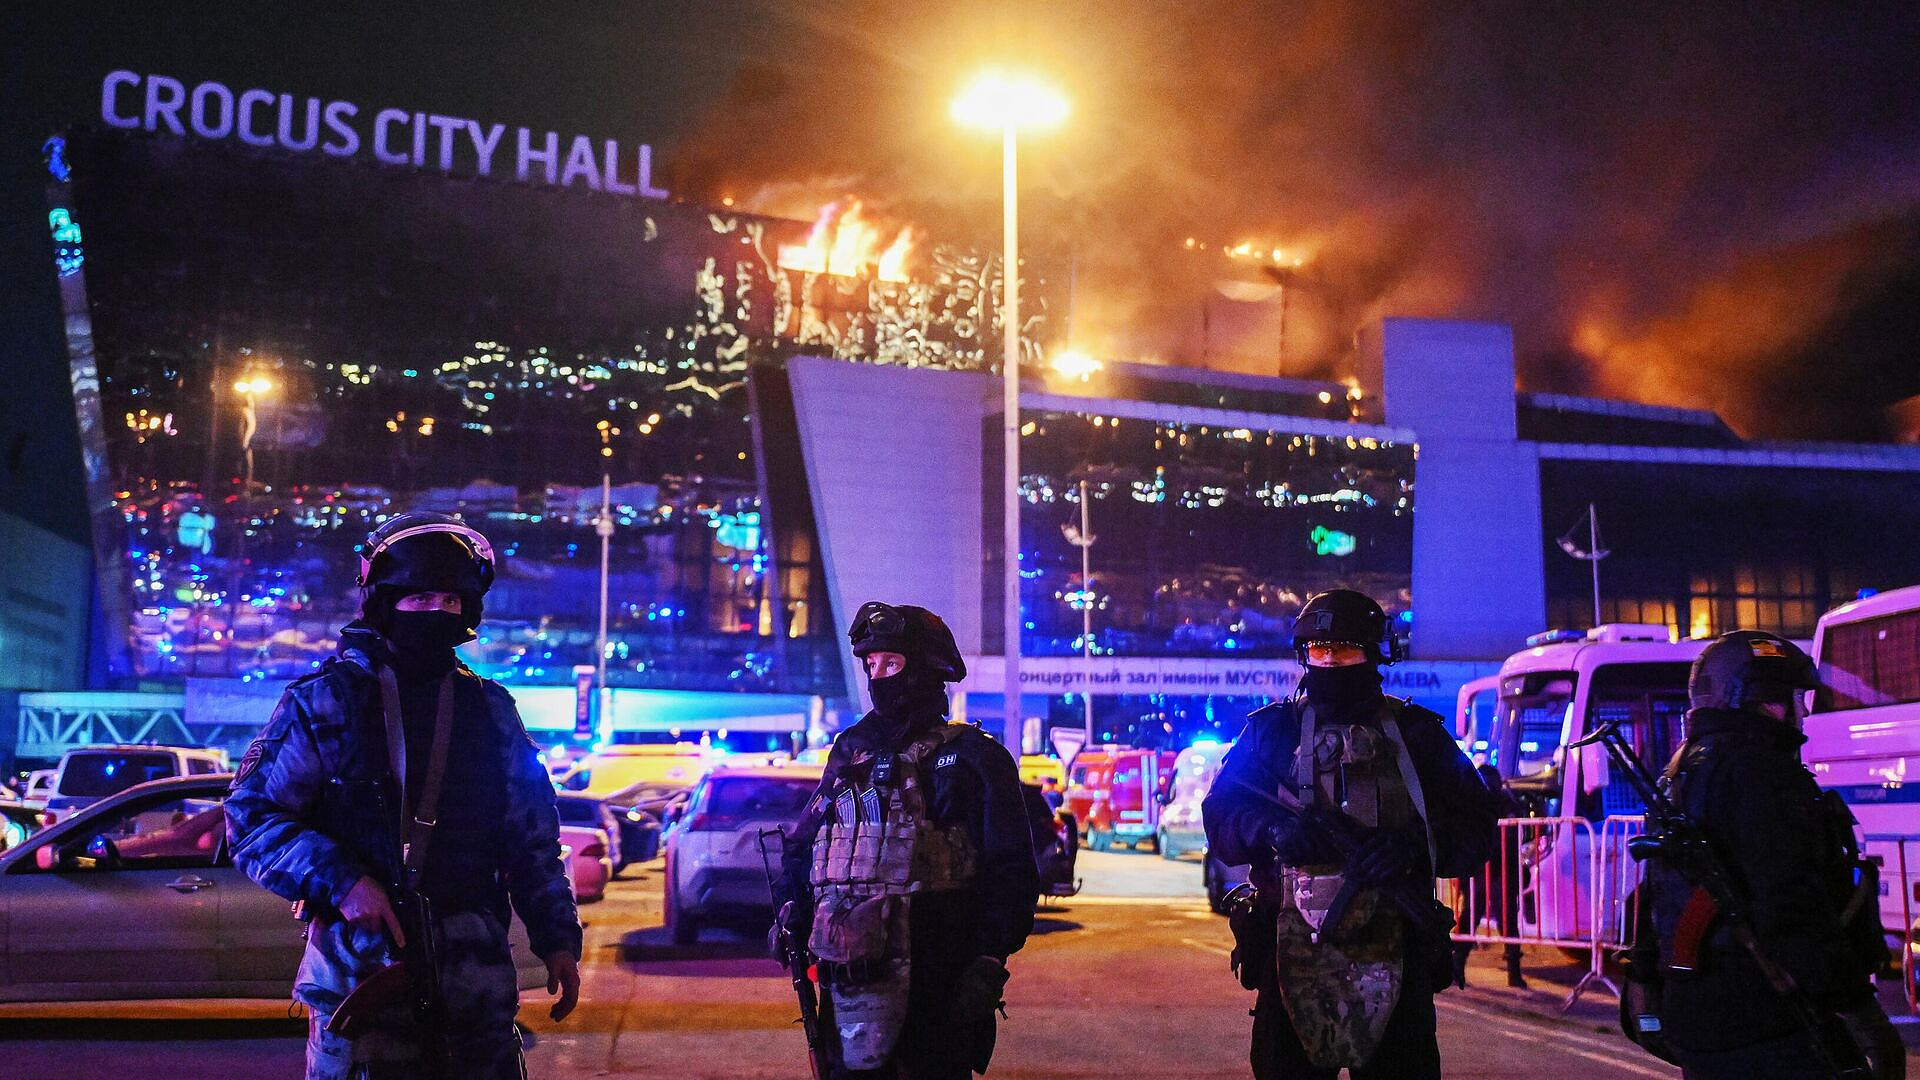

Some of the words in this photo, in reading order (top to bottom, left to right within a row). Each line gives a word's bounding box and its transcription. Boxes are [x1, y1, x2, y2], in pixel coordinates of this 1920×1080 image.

[101, 69, 361, 158] CROCUS
[374, 108, 505, 176] CITY
[517, 127, 669, 199] HALL
[1020, 667, 1120, 687] онцертный
[1127, 671, 1157, 684] зал
[1163, 672, 1220, 685] имени
[1384, 671, 1441, 688] АЕВА
[937, 755, 955, 767] ОН
